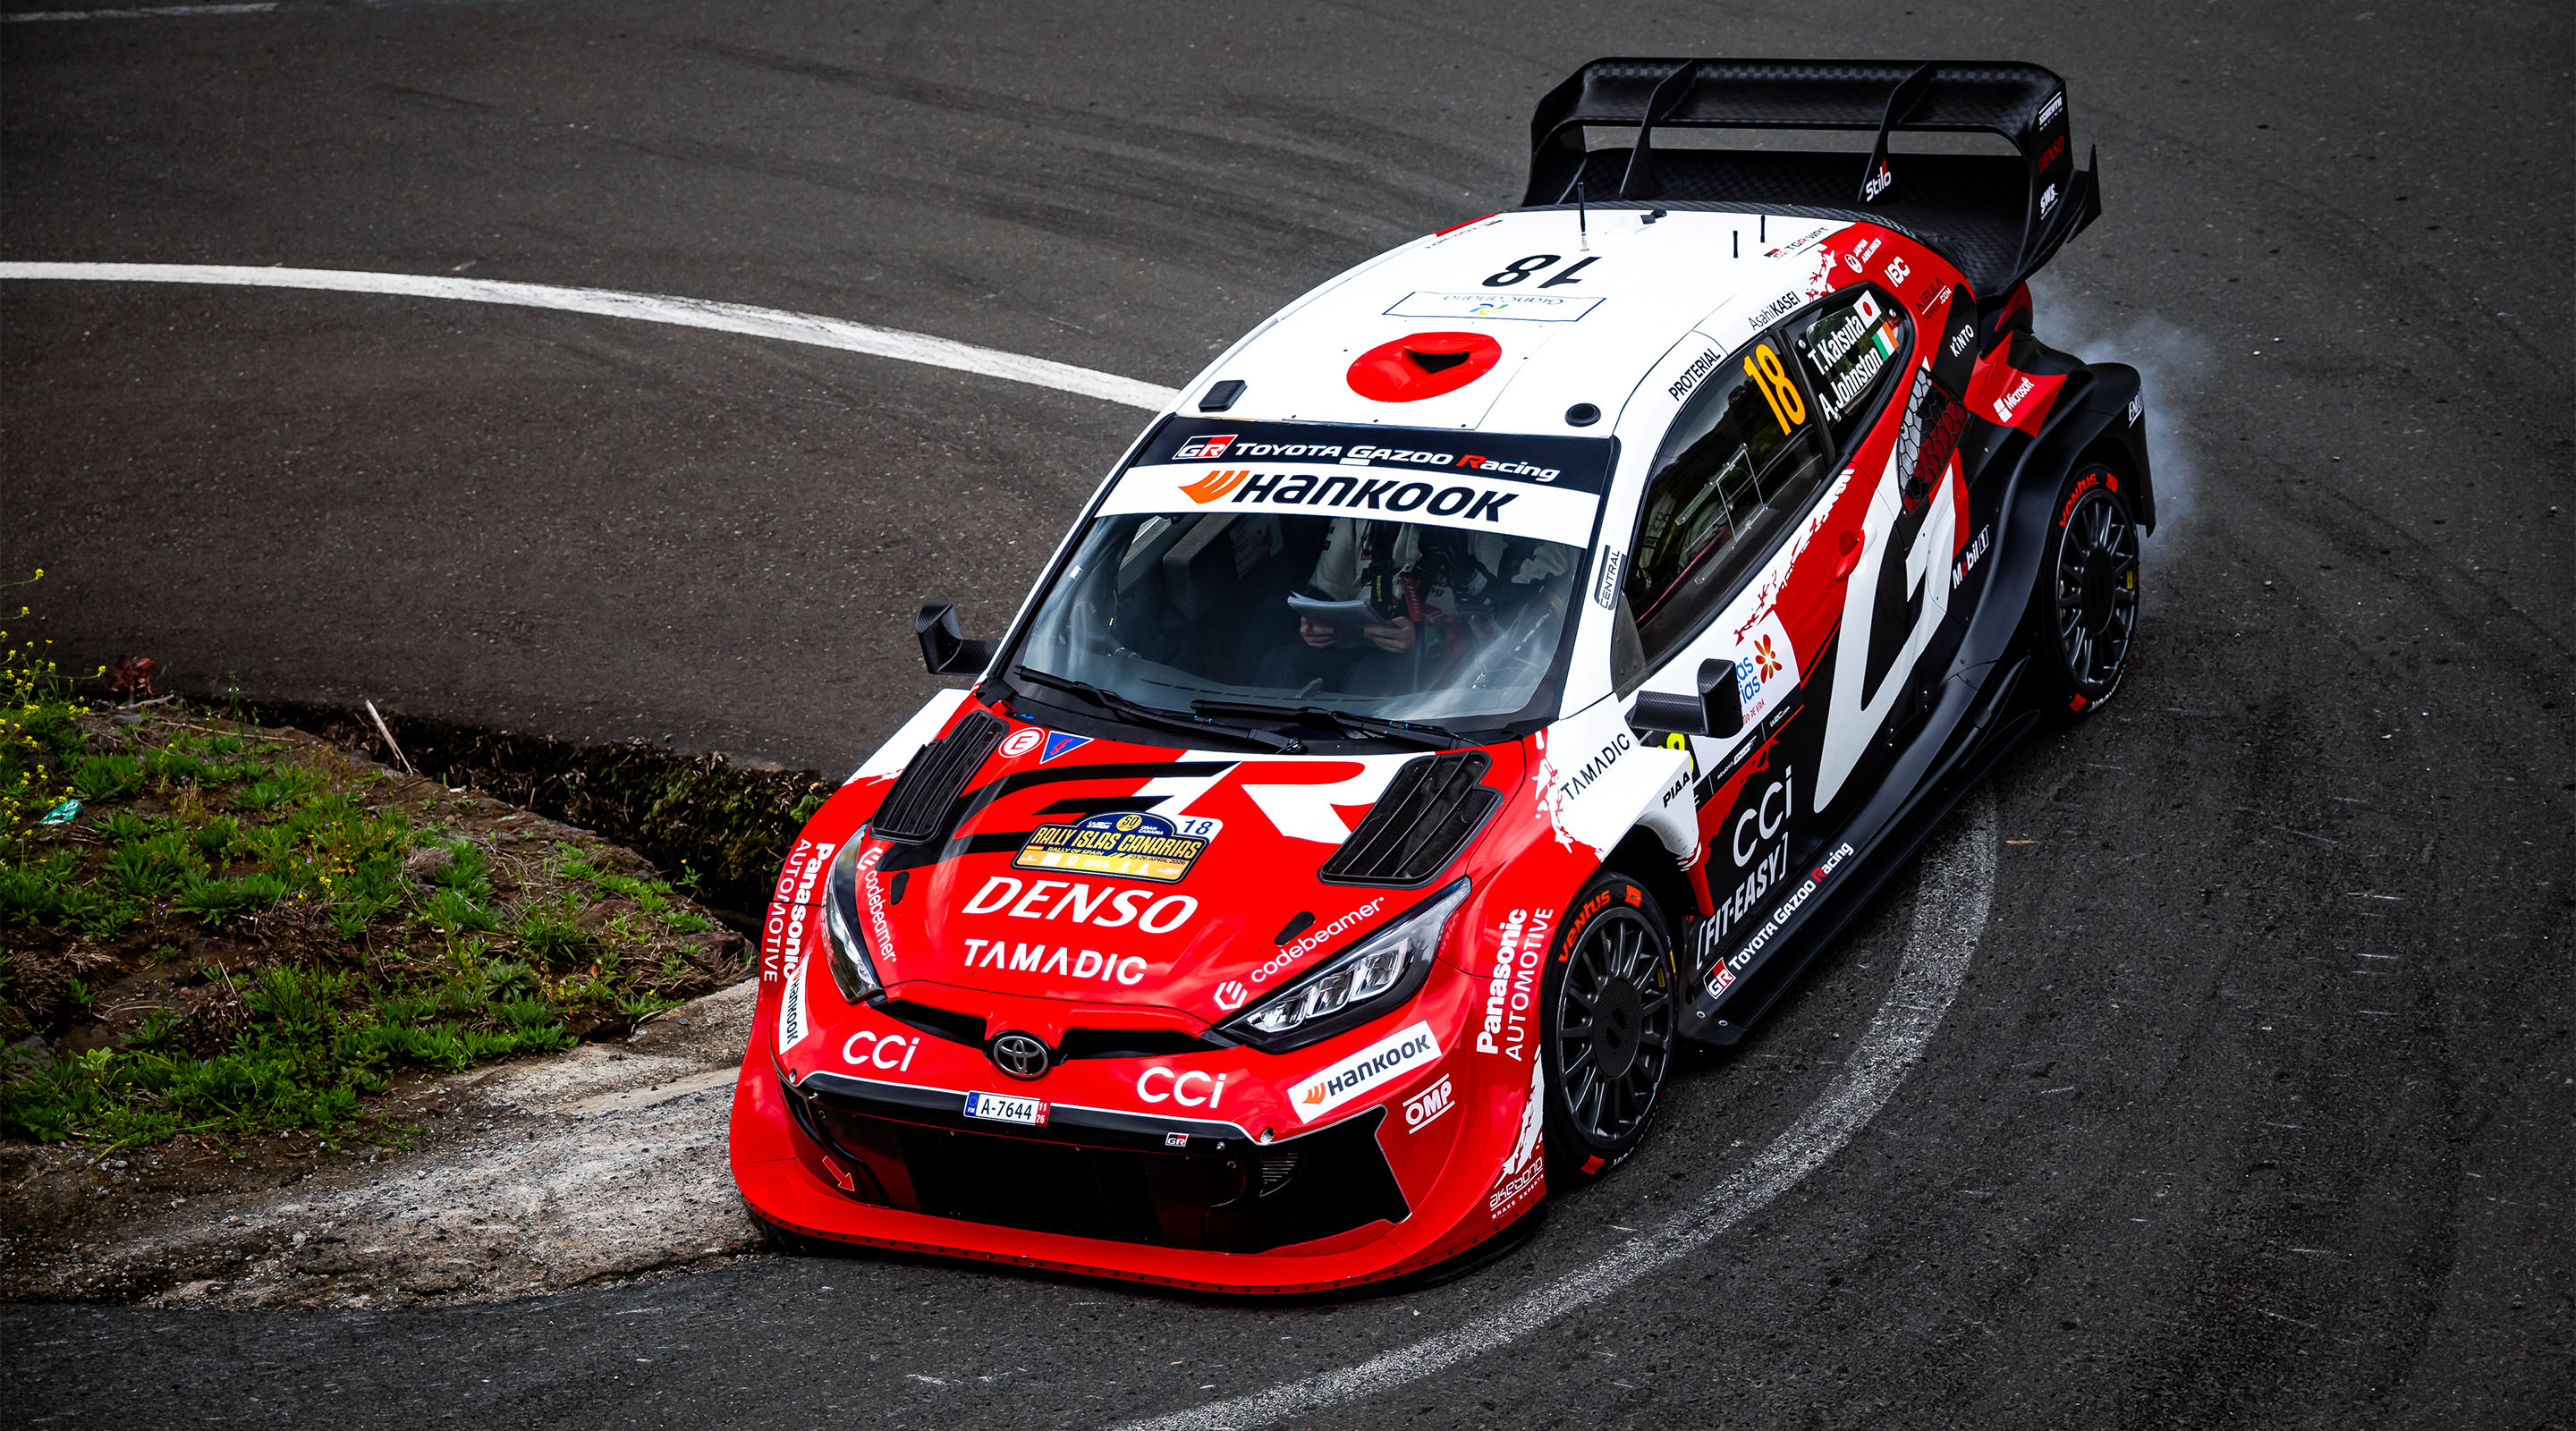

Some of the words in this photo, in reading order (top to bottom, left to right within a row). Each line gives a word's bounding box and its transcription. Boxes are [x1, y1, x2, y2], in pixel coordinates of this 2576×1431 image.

[2039, 135, 2064, 174] DENSO
[1866, 157, 1892, 202] Stilo
[1852, 238, 1868, 258] JAPAN
[1860, 237, 1882, 264] AIRLINES
[1482, 255, 1602, 288] 18
[1748, 291, 1801, 332] AsahiKASEI
[1667, 347, 1722, 402] PROTERIAL
[1743, 343, 1809, 436] 18
[2003, 377, 2035, 411] Microsoft
[1178, 443, 1229, 459] GR
[1235, 443, 1343, 459] TOYOTA
[1346, 445, 1452, 466] GAZOO
[1456, 454, 1561, 483] Racing
[1600, 551, 1620, 609] CENTRAL
[1953, 540, 1979, 589] Mobil
[1011, 736, 1033, 750] E
[1561, 733, 1631, 800] TAMADIC
[1663, 771, 1690, 809] PIAA
[1031, 827, 1078, 846] RALLY
[1072, 831, 1119, 851] ISLAS
[1117, 834, 1202, 859] CANARIAS
[1183, 820, 1213, 834] 18
[763, 838, 811, 982] AUTOMOTIVE
[784, 843, 835, 978] Panasonic
[865, 870, 897, 962] codebeamer
[962, 876, 1199, 934] DENSO
[1707, 969, 1736, 997] GR
[1728, 921, 1778, 971] TOYOTA
[1773, 879, 1816, 925] GAZOO
[1811, 842, 1854, 883] Racing
[1250, 897, 1383, 982] codebeamer
[963, 938, 1148, 986] TAMADIC
[1476, 909, 1528, 1054] Panasonic
[1505, 908, 1553, 1062] AUTOMOTIVE
[980, 1098, 1032, 1120] A-7644
[1036, 1114, 1045, 1123] 26
[1039, 1102, 1047, 1112] 11
[1405, 1080, 1452, 1127] OMP
[1166, 1137, 1186, 1147] GR
[1520, 1174, 1544, 1200] EXPERTS
[1492, 1200, 1516, 1219] BRAKE
